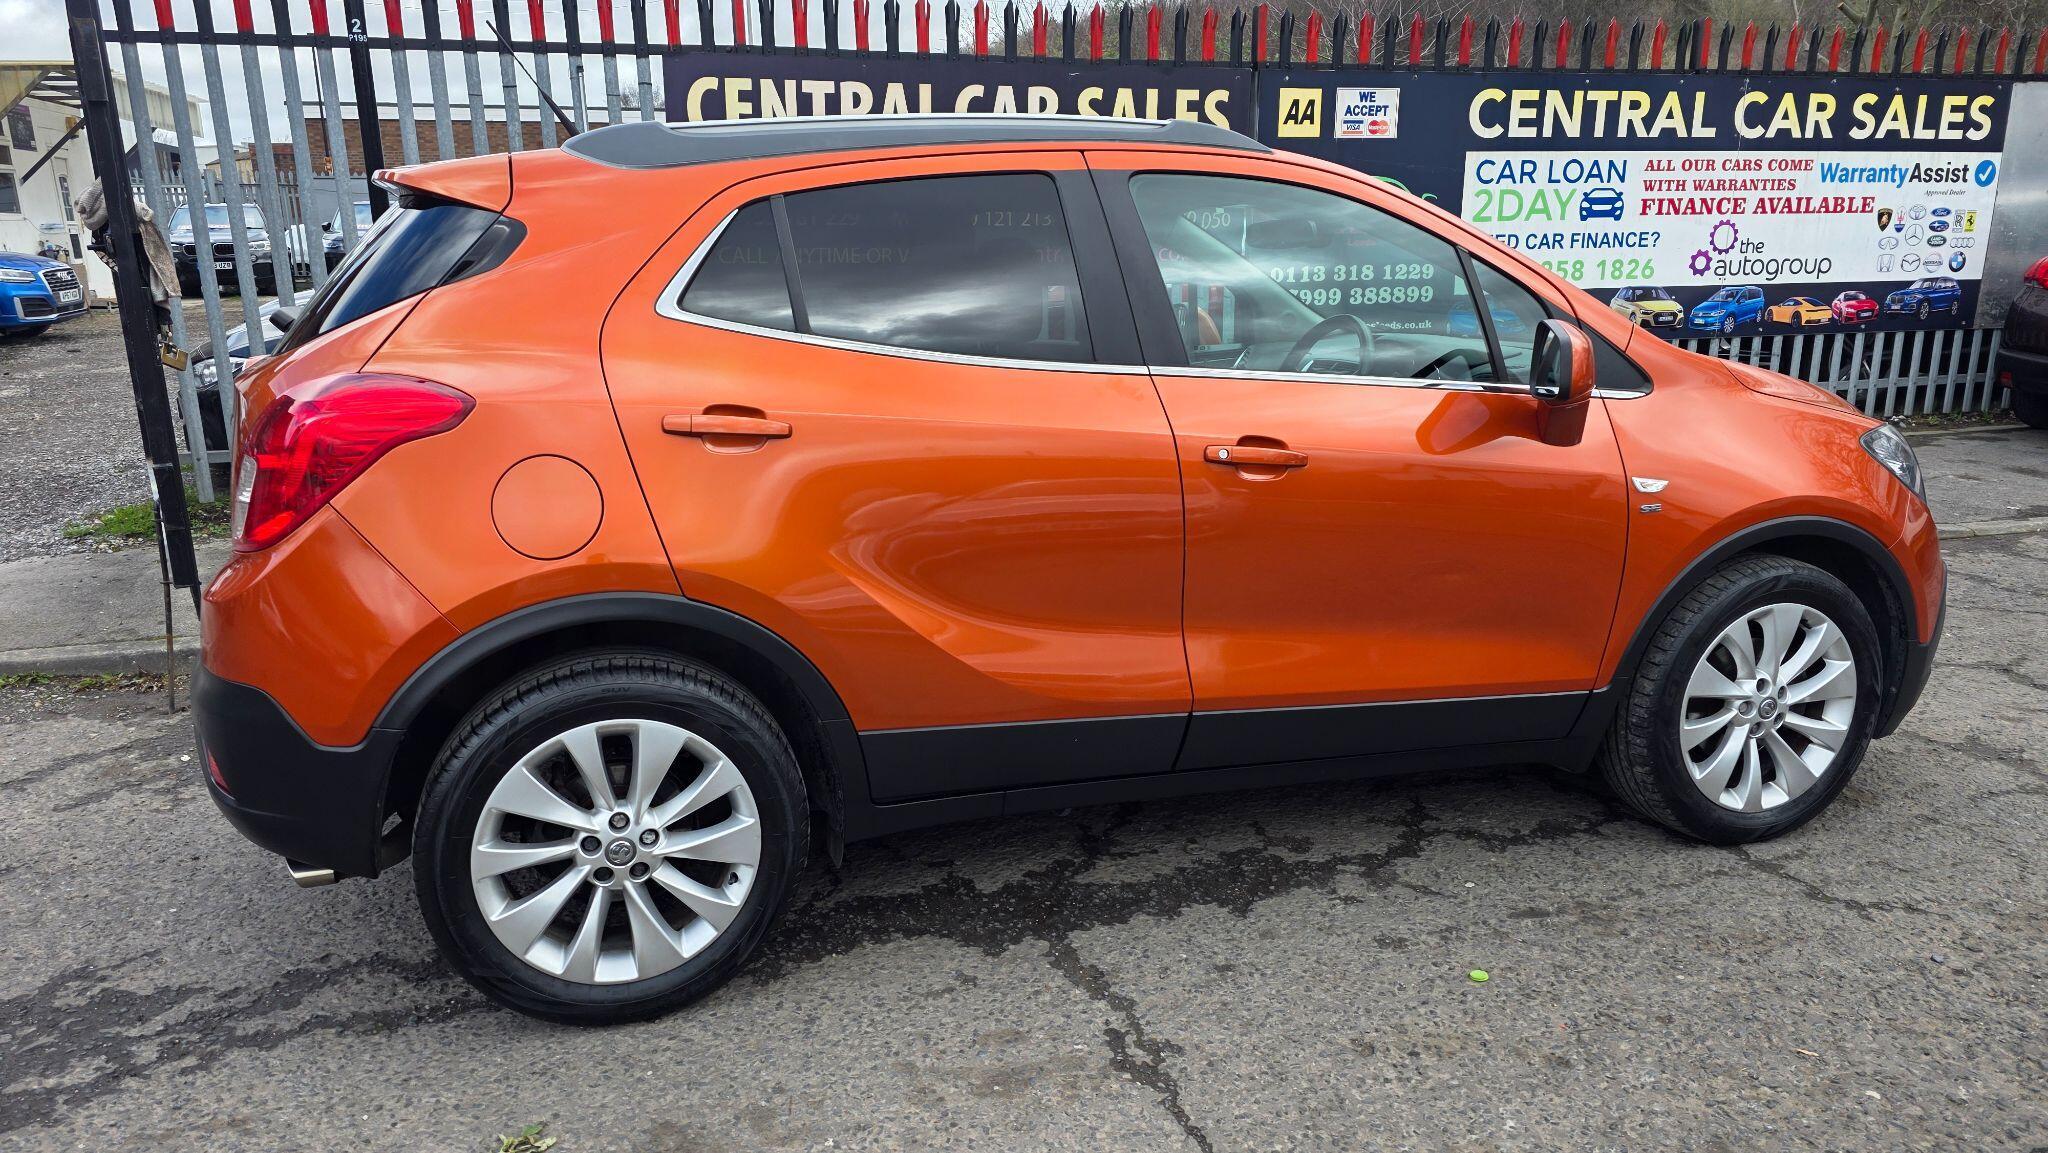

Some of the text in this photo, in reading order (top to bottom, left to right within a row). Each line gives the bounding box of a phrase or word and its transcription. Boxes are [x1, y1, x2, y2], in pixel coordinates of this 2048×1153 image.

[351, 18, 362, 33] 2
[686, 76, 1231, 130] CENTRAL CAR SALES
[1359, 91, 1377, 103] WE
[1283, 99, 1316, 125] AA
[1344, 105, 1390, 116] ACCEPT
[1468, 88, 1996, 141] CENTRAL CAR SALES
[1476, 158, 1628, 184] CAR LOAN
[1644, 158, 1815, 172] ALL OUR CARS COME
[1643, 178, 1797, 192] WITH WARRANTIES
[1924, 189, 1949, 197] Approved
[1472, 188, 1578, 223] 2DAY
[1639, 196, 1876, 216] FINANCE AVAILABLE
[1525, 233, 1565, 249] CAR
[1570, 231, 1661, 249] FINANCE?
[1739, 237, 1765, 254] the
[1270, 263, 1435, 282] 0113 318 1229
[1597, 258, 1655, 281] 1826
[1713, 255, 1832, 281] autogroup
[1350, 285, 1434, 304] 388899
[600, 686, 632, 695] SUV
